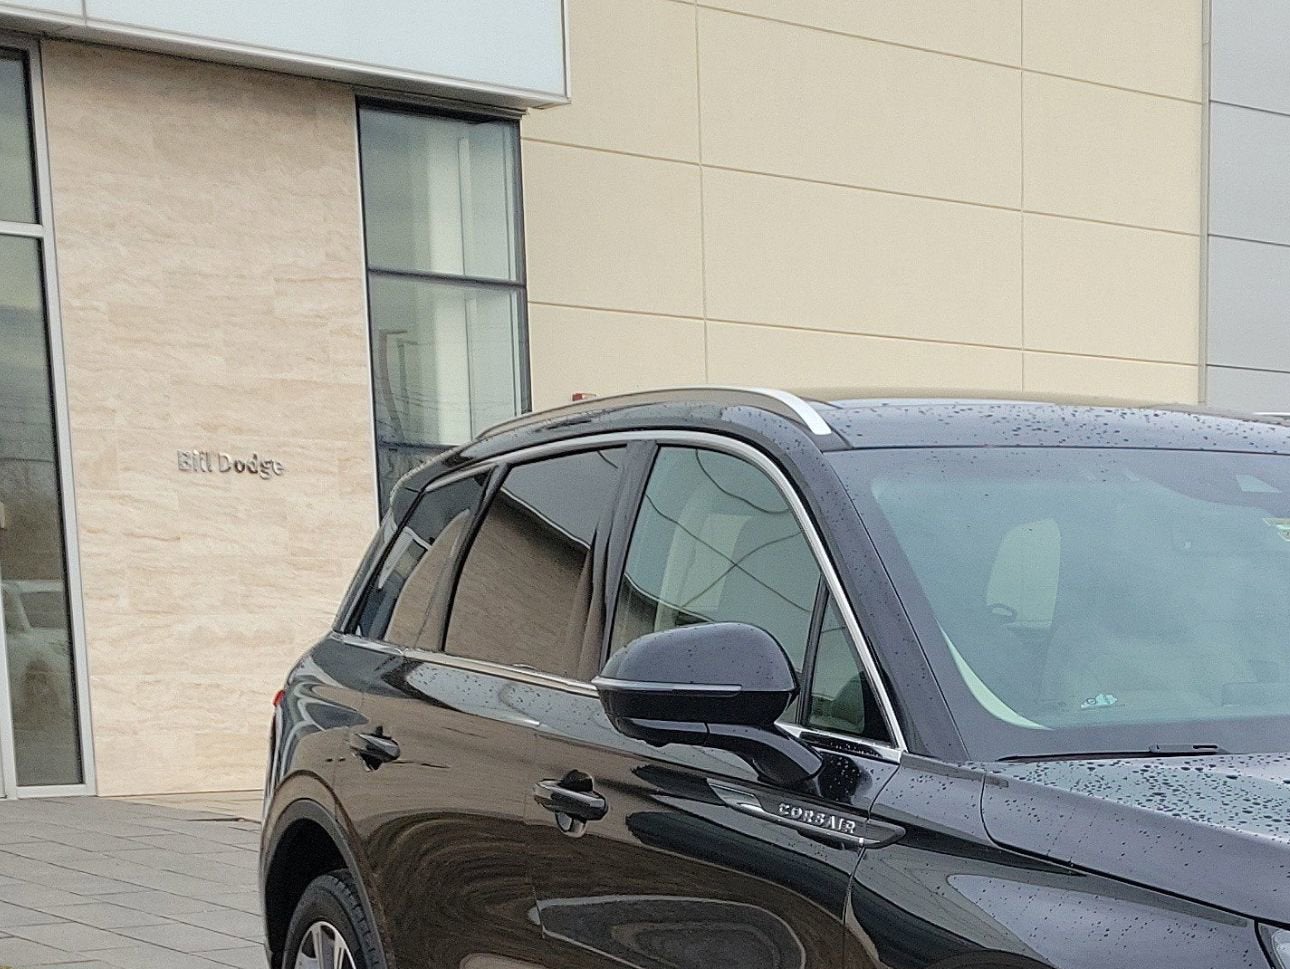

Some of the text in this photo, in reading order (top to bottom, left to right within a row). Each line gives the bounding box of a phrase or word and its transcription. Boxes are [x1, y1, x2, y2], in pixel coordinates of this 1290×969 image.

[177, 449, 284, 480] Bill Dodge
[778, 802, 857, 834] CORSAIR
